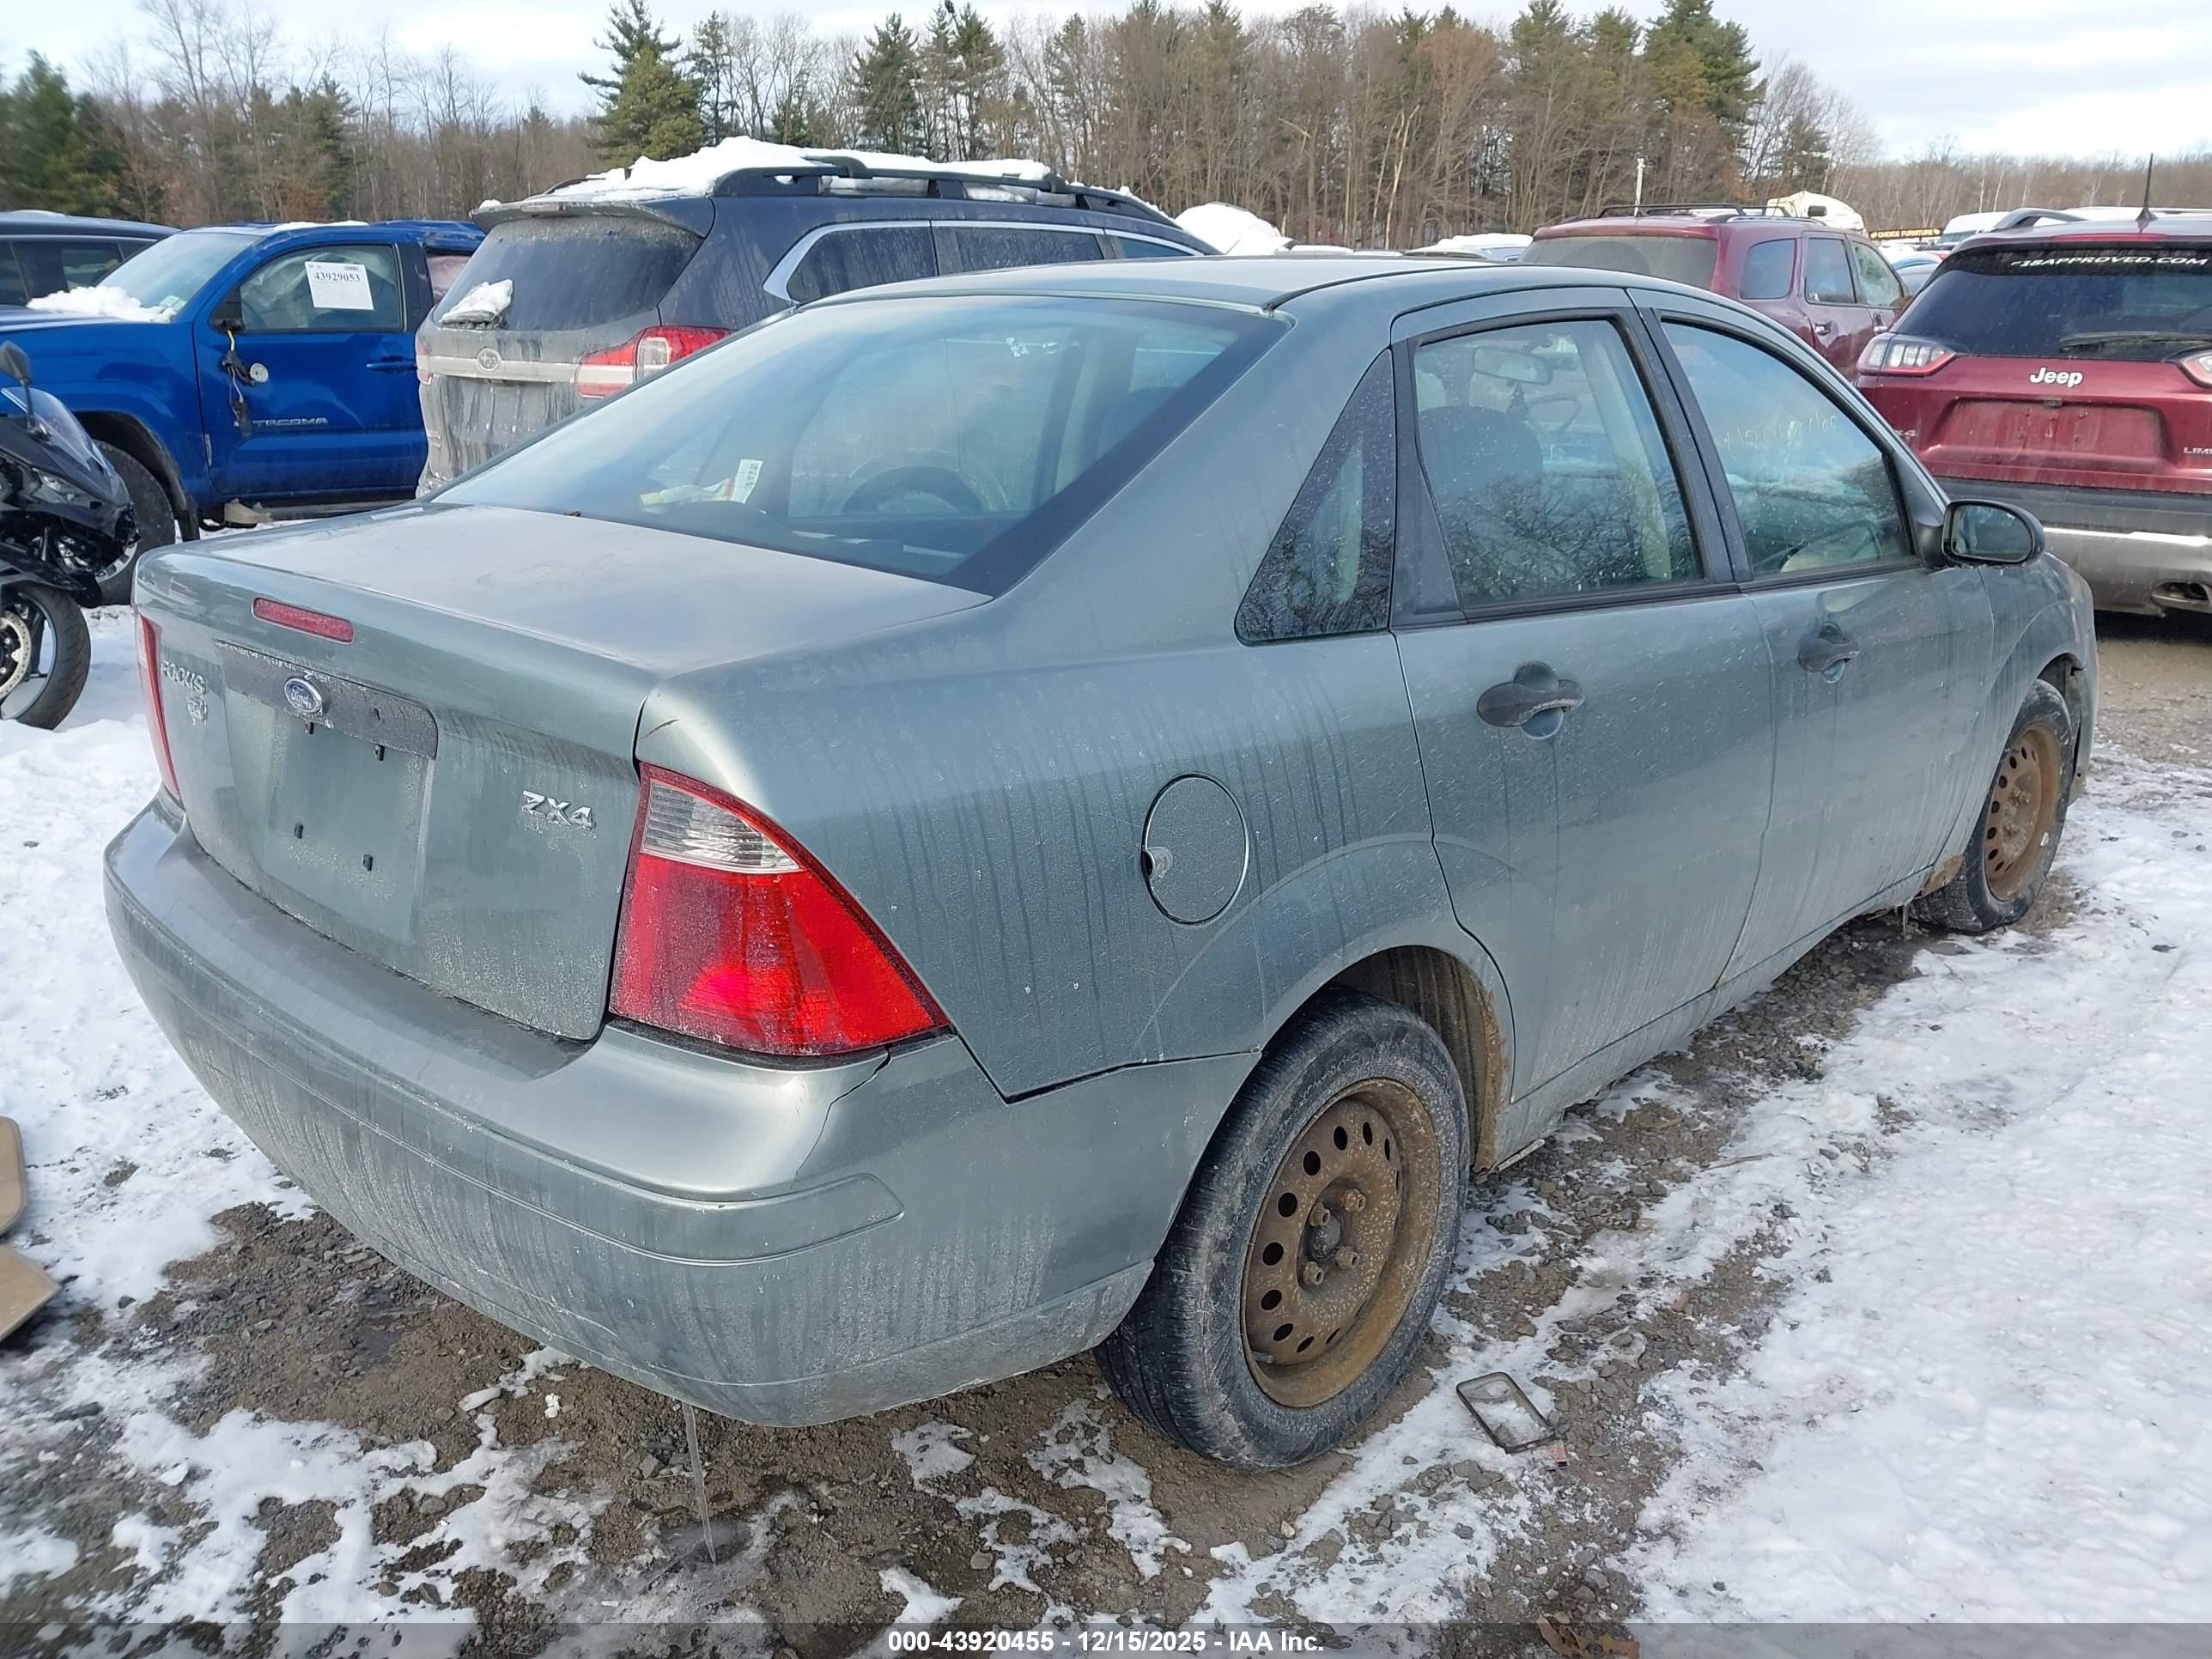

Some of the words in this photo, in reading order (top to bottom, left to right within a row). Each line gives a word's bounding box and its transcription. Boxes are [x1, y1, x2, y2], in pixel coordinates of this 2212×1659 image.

[314, 271, 361, 283] 43929053
[2029, 367, 2084, 388] Jeep
[252, 417, 329, 427] TACOMA
[160, 659, 207, 695] FOCUS
[522, 790, 594, 830] ZX4
